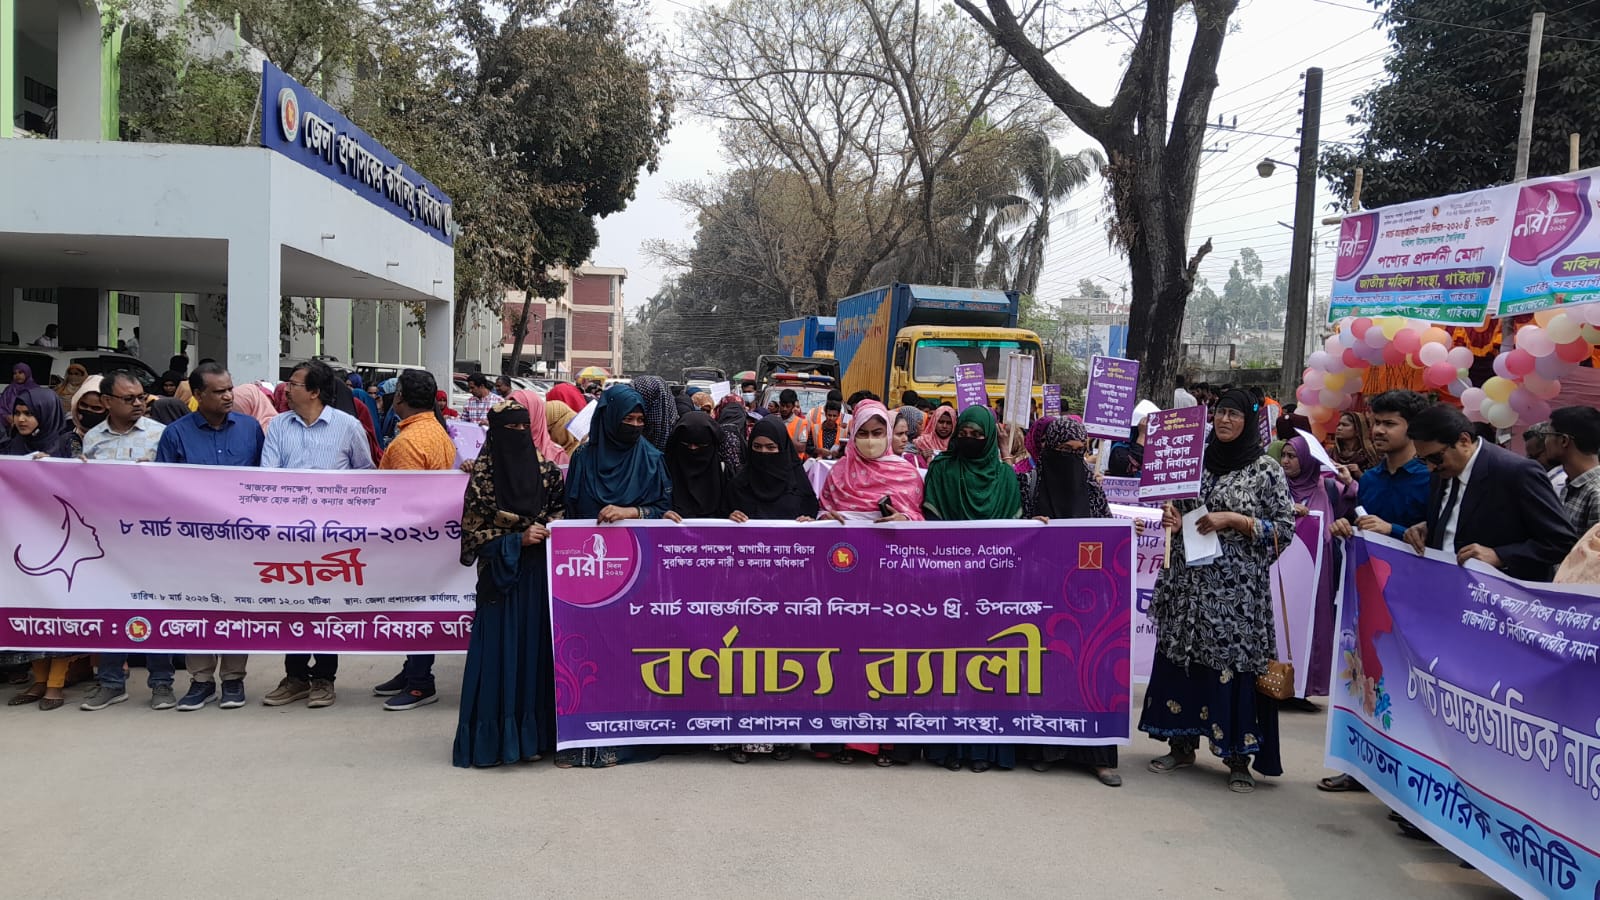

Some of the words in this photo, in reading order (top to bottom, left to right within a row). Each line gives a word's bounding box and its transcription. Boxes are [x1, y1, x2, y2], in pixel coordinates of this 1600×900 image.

[302, 111, 336, 165] জেলা
[337, 134, 383, 192] প্রশাসকের
[1377, 254, 1411, 269] পণ্যের
[1413, 246, 1452, 265] প্রদর্শনী
[1454, 246, 1485, 263] মেলা
[1359, 274, 1384, 289] জাতীয়
[1387, 274, 1416, 288] মহিলা
[1445, 269, 1486, 286] গাইবান্ধা
[1172, 434, 1195, 445] হোক
[1155, 446, 1191, 457] অঙ্গীকার
[1144, 458, 1164, 471] নারী
[1166, 456, 1199, 469] নির্যাতন
[1153, 473, 1167, 482] নয়
[280, 485, 313, 495] পদক্ষেপ,
[315, 484, 347, 494] আগামীর
[239, 494, 268, 505] সুরক্ষিত
[270, 497, 289, 505] হোক
[291, 495, 308, 505] নারী
[320, 498, 343, 506] কন্যার
[119, 518, 134, 535] ৮
[139, 517, 172, 536] মার্চ
[176, 517, 271, 541] আন্তর্জাতিক
[277, 519, 318, 543] নারী
[322, 519, 440, 544] দিবস-২০২৬
[700, 545, 735, 556] পদক্ষেপ,
[737, 542, 770, 554] আগামীর
[773, 545, 791, 554] ন্যায়
[793, 542, 815, 554] বিচার
[932, 545, 975, 556] Justice,
[977, 544, 1016, 556] Action,
[556, 553, 626, 579] নারী
[662, 556, 693, 569] সুরক্ষিত
[696, 558, 715, 568] হোক
[718, 555, 734, 568] নারী
[737, 559, 745, 567] ও
[747, 558, 771, 568] কন্যার
[879, 558, 898, 569] For
[900, 558, 915, 569] All
[918, 558, 961, 569] Women
[964, 558, 986, 569] and
[168, 592, 182, 601] মার্চ
[258, 596, 276, 605] বেলা
[308, 595, 331, 605] ঘটিকা
[365, 596, 385, 604] জেলা
[388, 594, 426, 604] প্রশাসকের
[629, 600, 643, 616] ৮
[650, 598, 682, 616] মার্চ
[687, 597, 779, 617] আন্তর্জাতিক
[784, 597, 823, 616] নারী
[827, 597, 937, 617] দিবস-২০২৬
[1491, 593, 1500, 606] ও
[1501, 596, 1528, 616] কন্যা
[1524, 599, 1555, 622] শিশুর
[1555, 606, 1593, 630] অধিকার
[159, 618, 208, 639] জেলা
[214, 619, 281, 640] প্রশাসন
[289, 620, 304, 637] ও
[311, 615, 366, 641] মহিলা
[373, 614, 434, 638] বিষয়ক
[1462, 609, 1498, 631] রাজনীতি
[1499, 621, 1505, 635] ও
[1506, 617, 1540, 647] নির্বাচনে
[1538, 630, 1570, 656] নারীর
[1569, 640, 1599, 664] সমান
[632, 625, 840, 696] বর্ণাঢ্য
[586, 717, 677, 734] আয়োজনে:
[686, 716, 733, 732] জেলা
[738, 714, 802, 732] প্রশাসন
[809, 716, 823, 730] ও
[830, 712, 889, 731] জাতীয়
[895, 712, 947, 732] মহিলা
[954, 715, 1004, 734] সংস্থা,
[1012, 715, 1087, 733] গাইবান্ধা
[1438, 679, 1560, 771] আন্তর্জাতিক
[1347, 724, 1403, 786] সচেতন
[1407, 765, 1491, 840] নাগরিক
[1497, 818, 1582, 890] কমিটি
